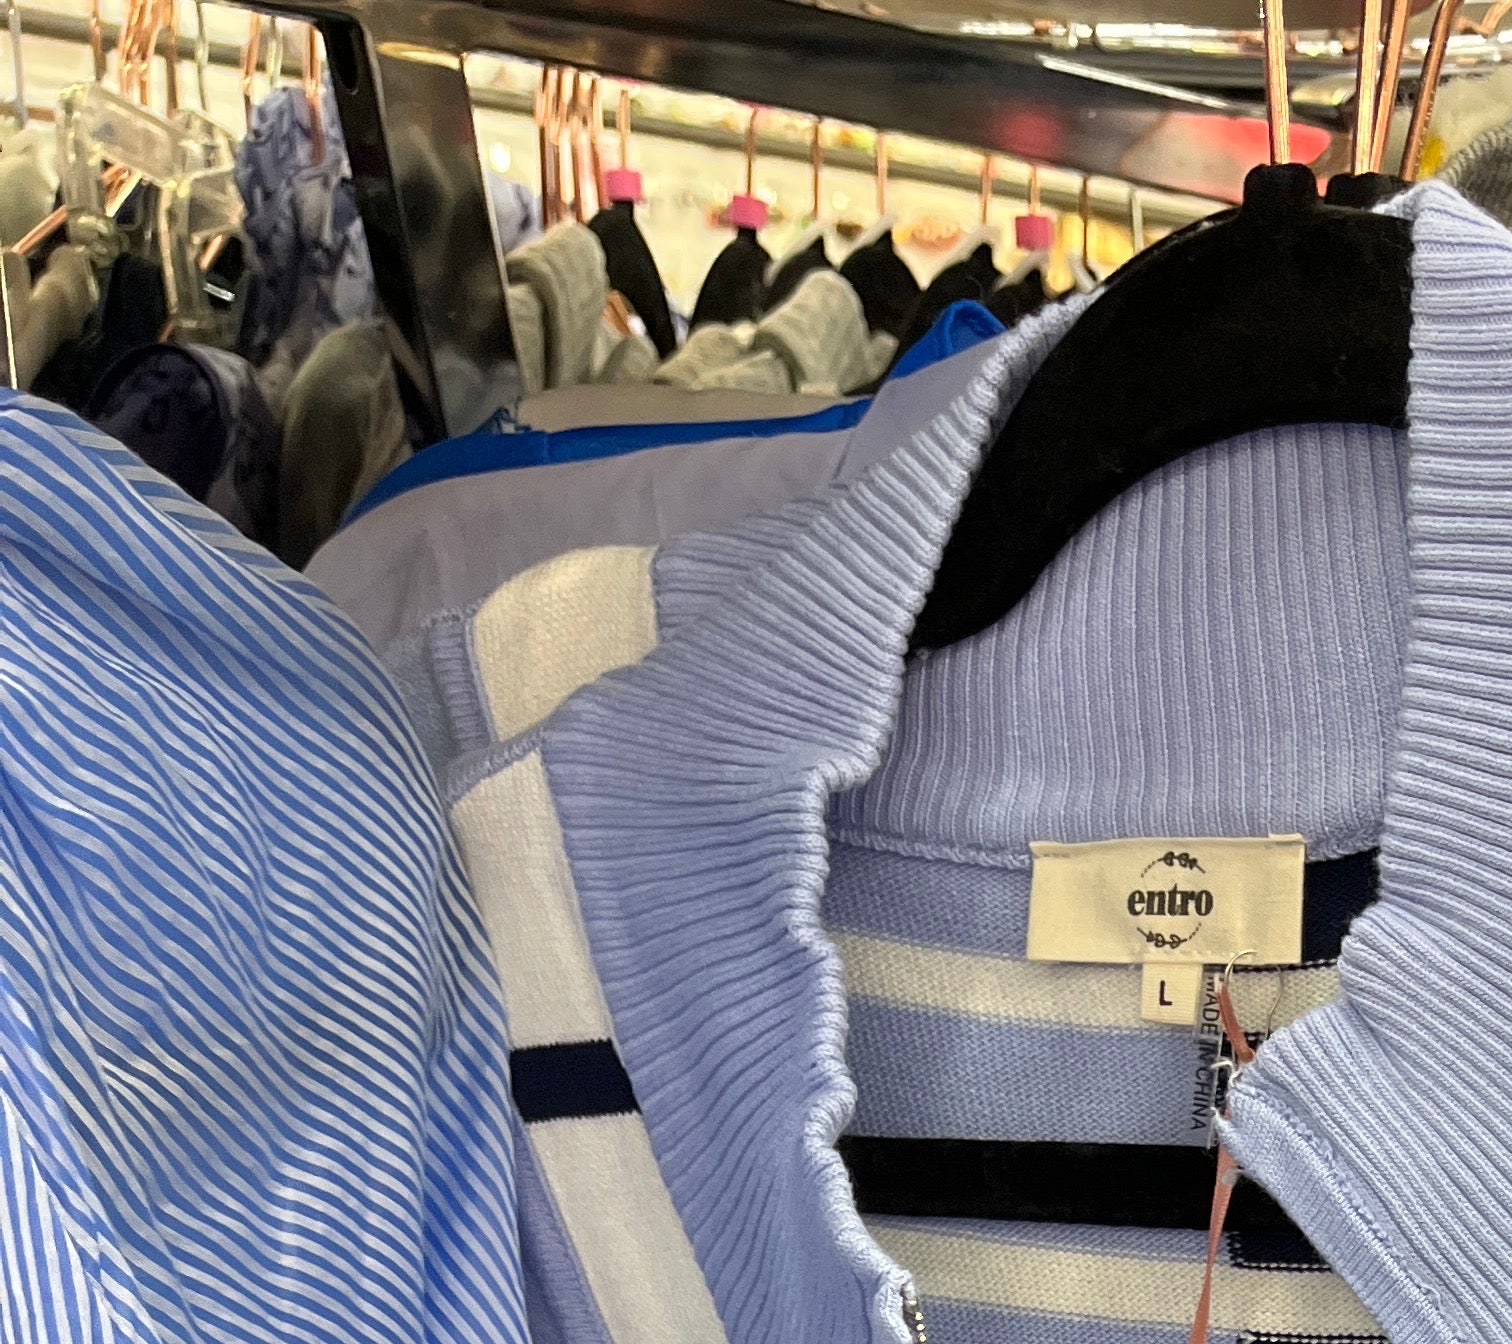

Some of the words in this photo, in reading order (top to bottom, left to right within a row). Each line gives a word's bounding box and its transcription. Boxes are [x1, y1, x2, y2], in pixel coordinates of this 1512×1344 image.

[1127, 884, 1213, 916] entro
[1159, 980, 1172, 1006] L
[1201, 976, 1223, 1035] MADE
[1190, 1066, 1213, 1131] CHINA
